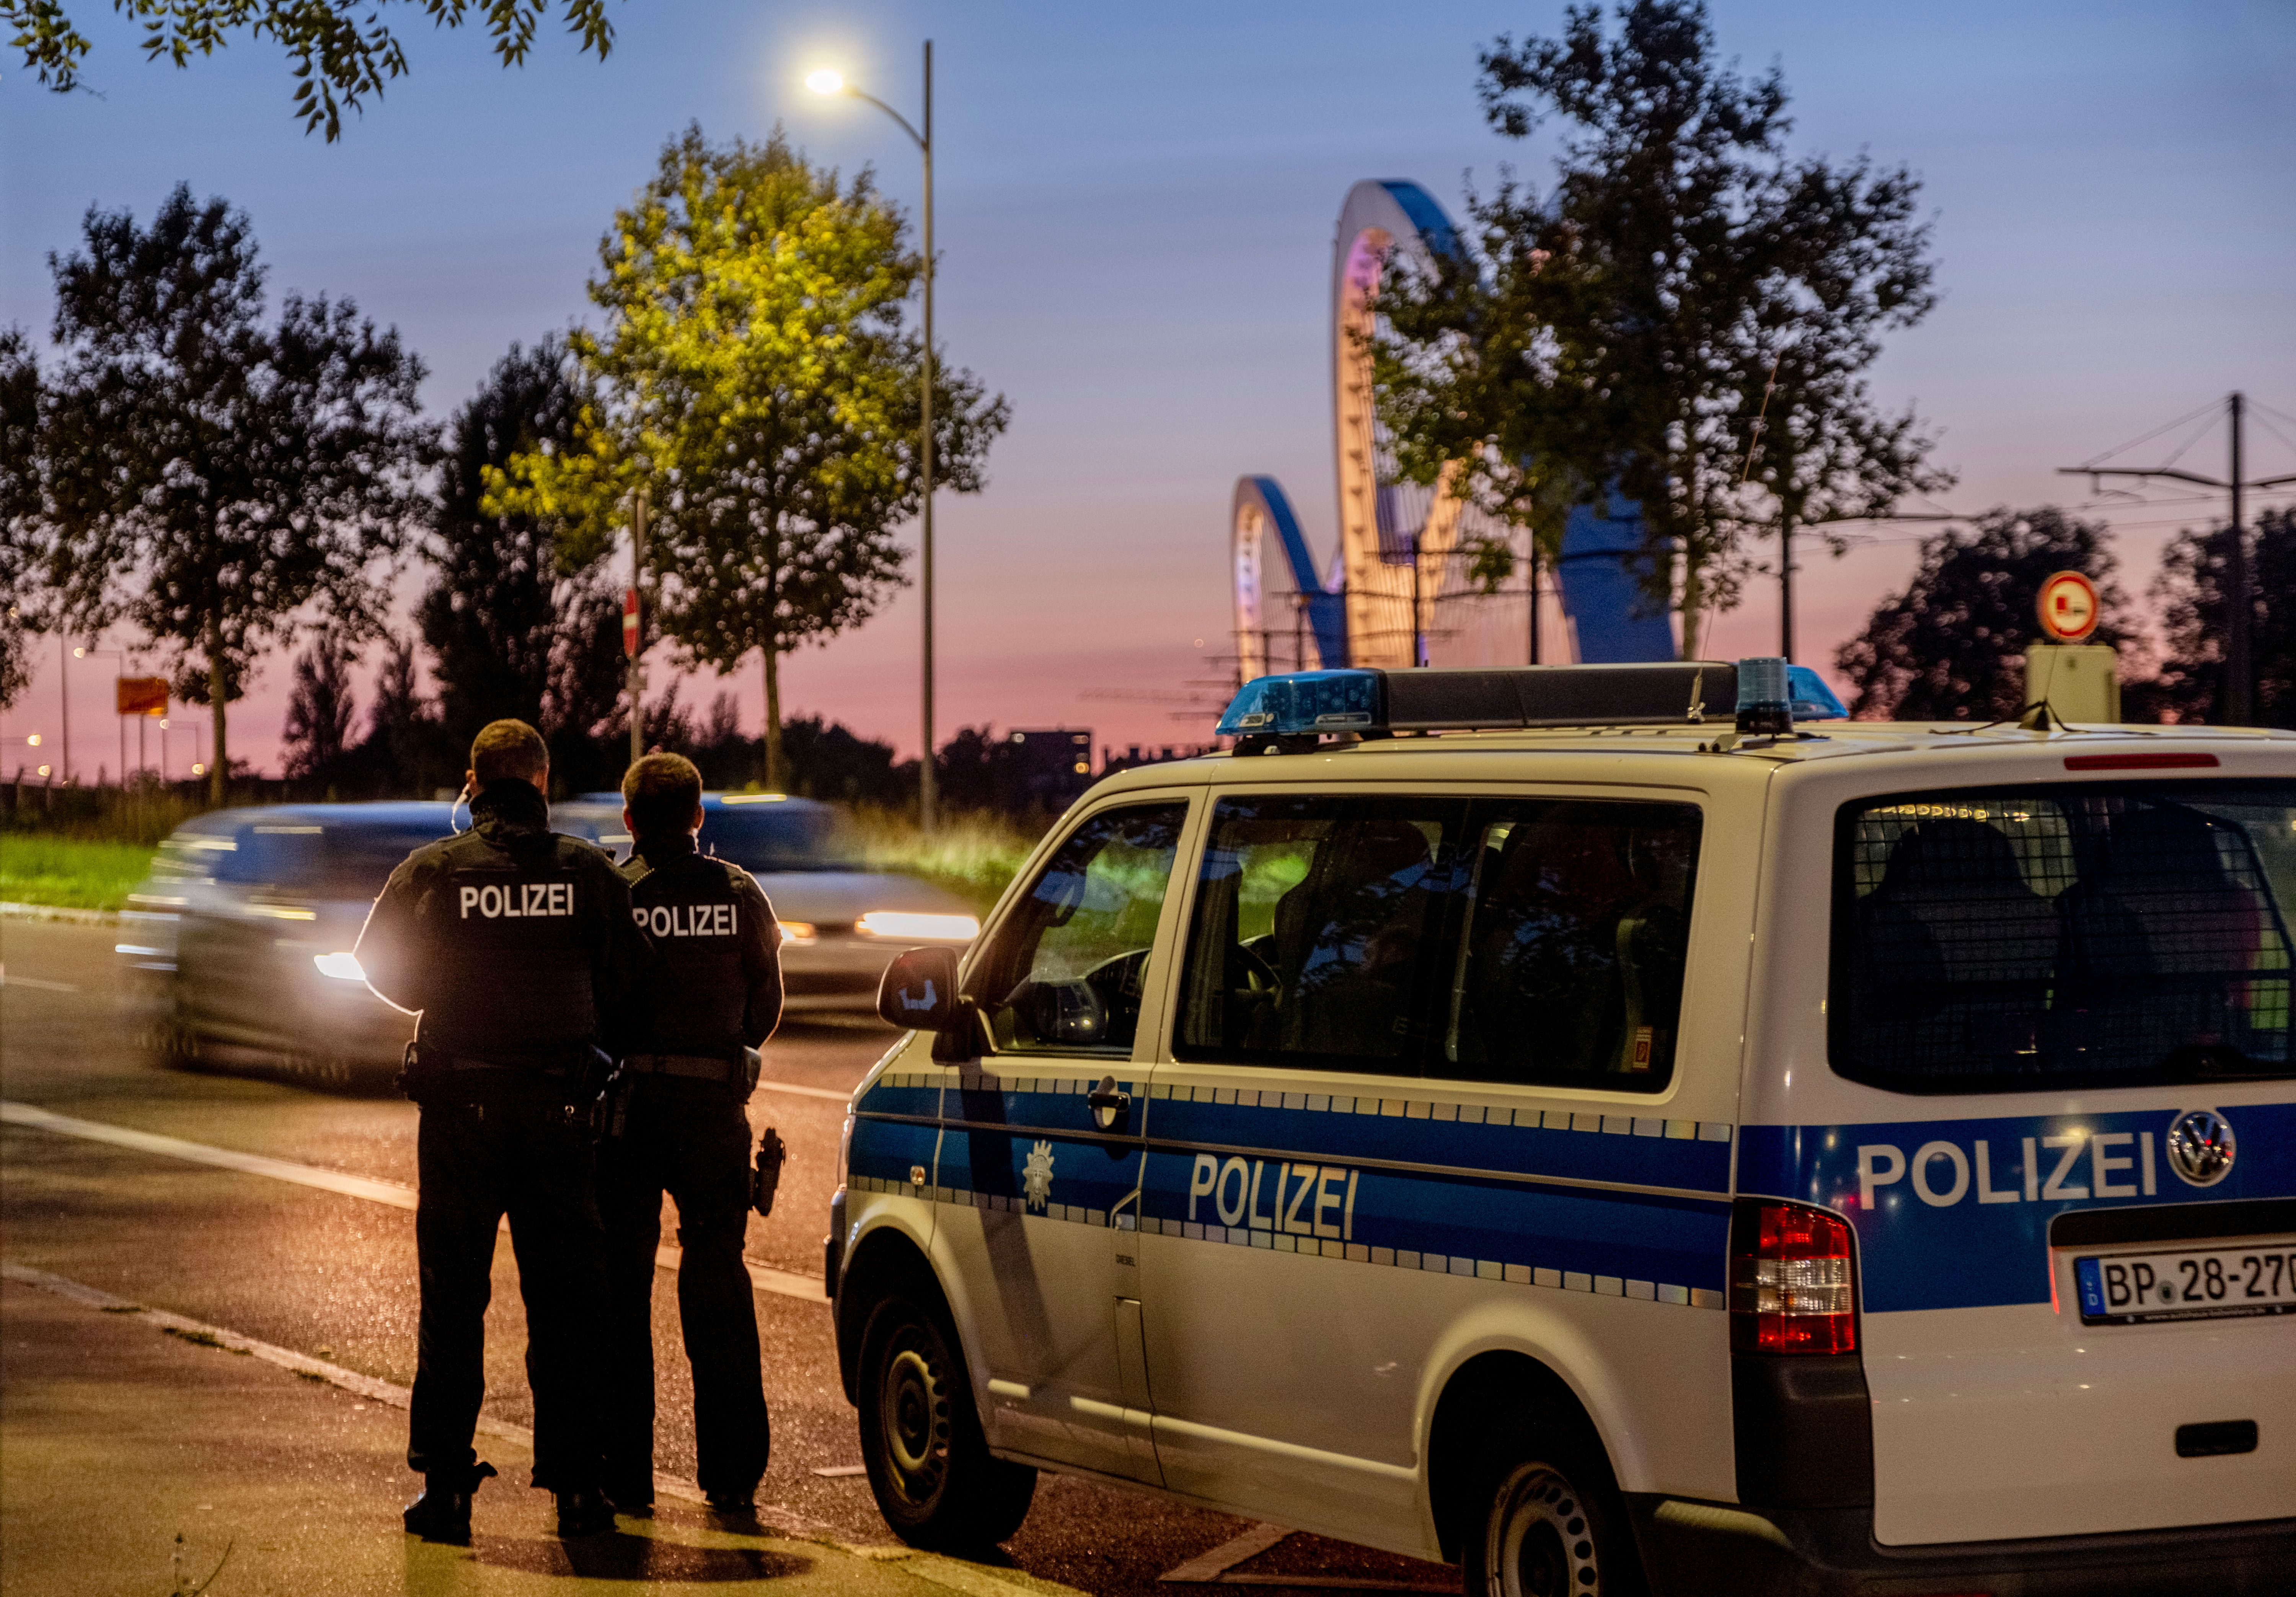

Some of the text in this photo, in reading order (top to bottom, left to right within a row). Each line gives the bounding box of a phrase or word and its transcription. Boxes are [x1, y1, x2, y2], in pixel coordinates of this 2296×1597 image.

[460, 883, 574, 919] POLIZEI
[632, 904, 737, 938] POLIZEI
[1857, 1131, 2157, 1210] POLIZEI
[1189, 1153, 1359, 1241] POLIZEI
[2105, 1263, 2155, 1306] BP
